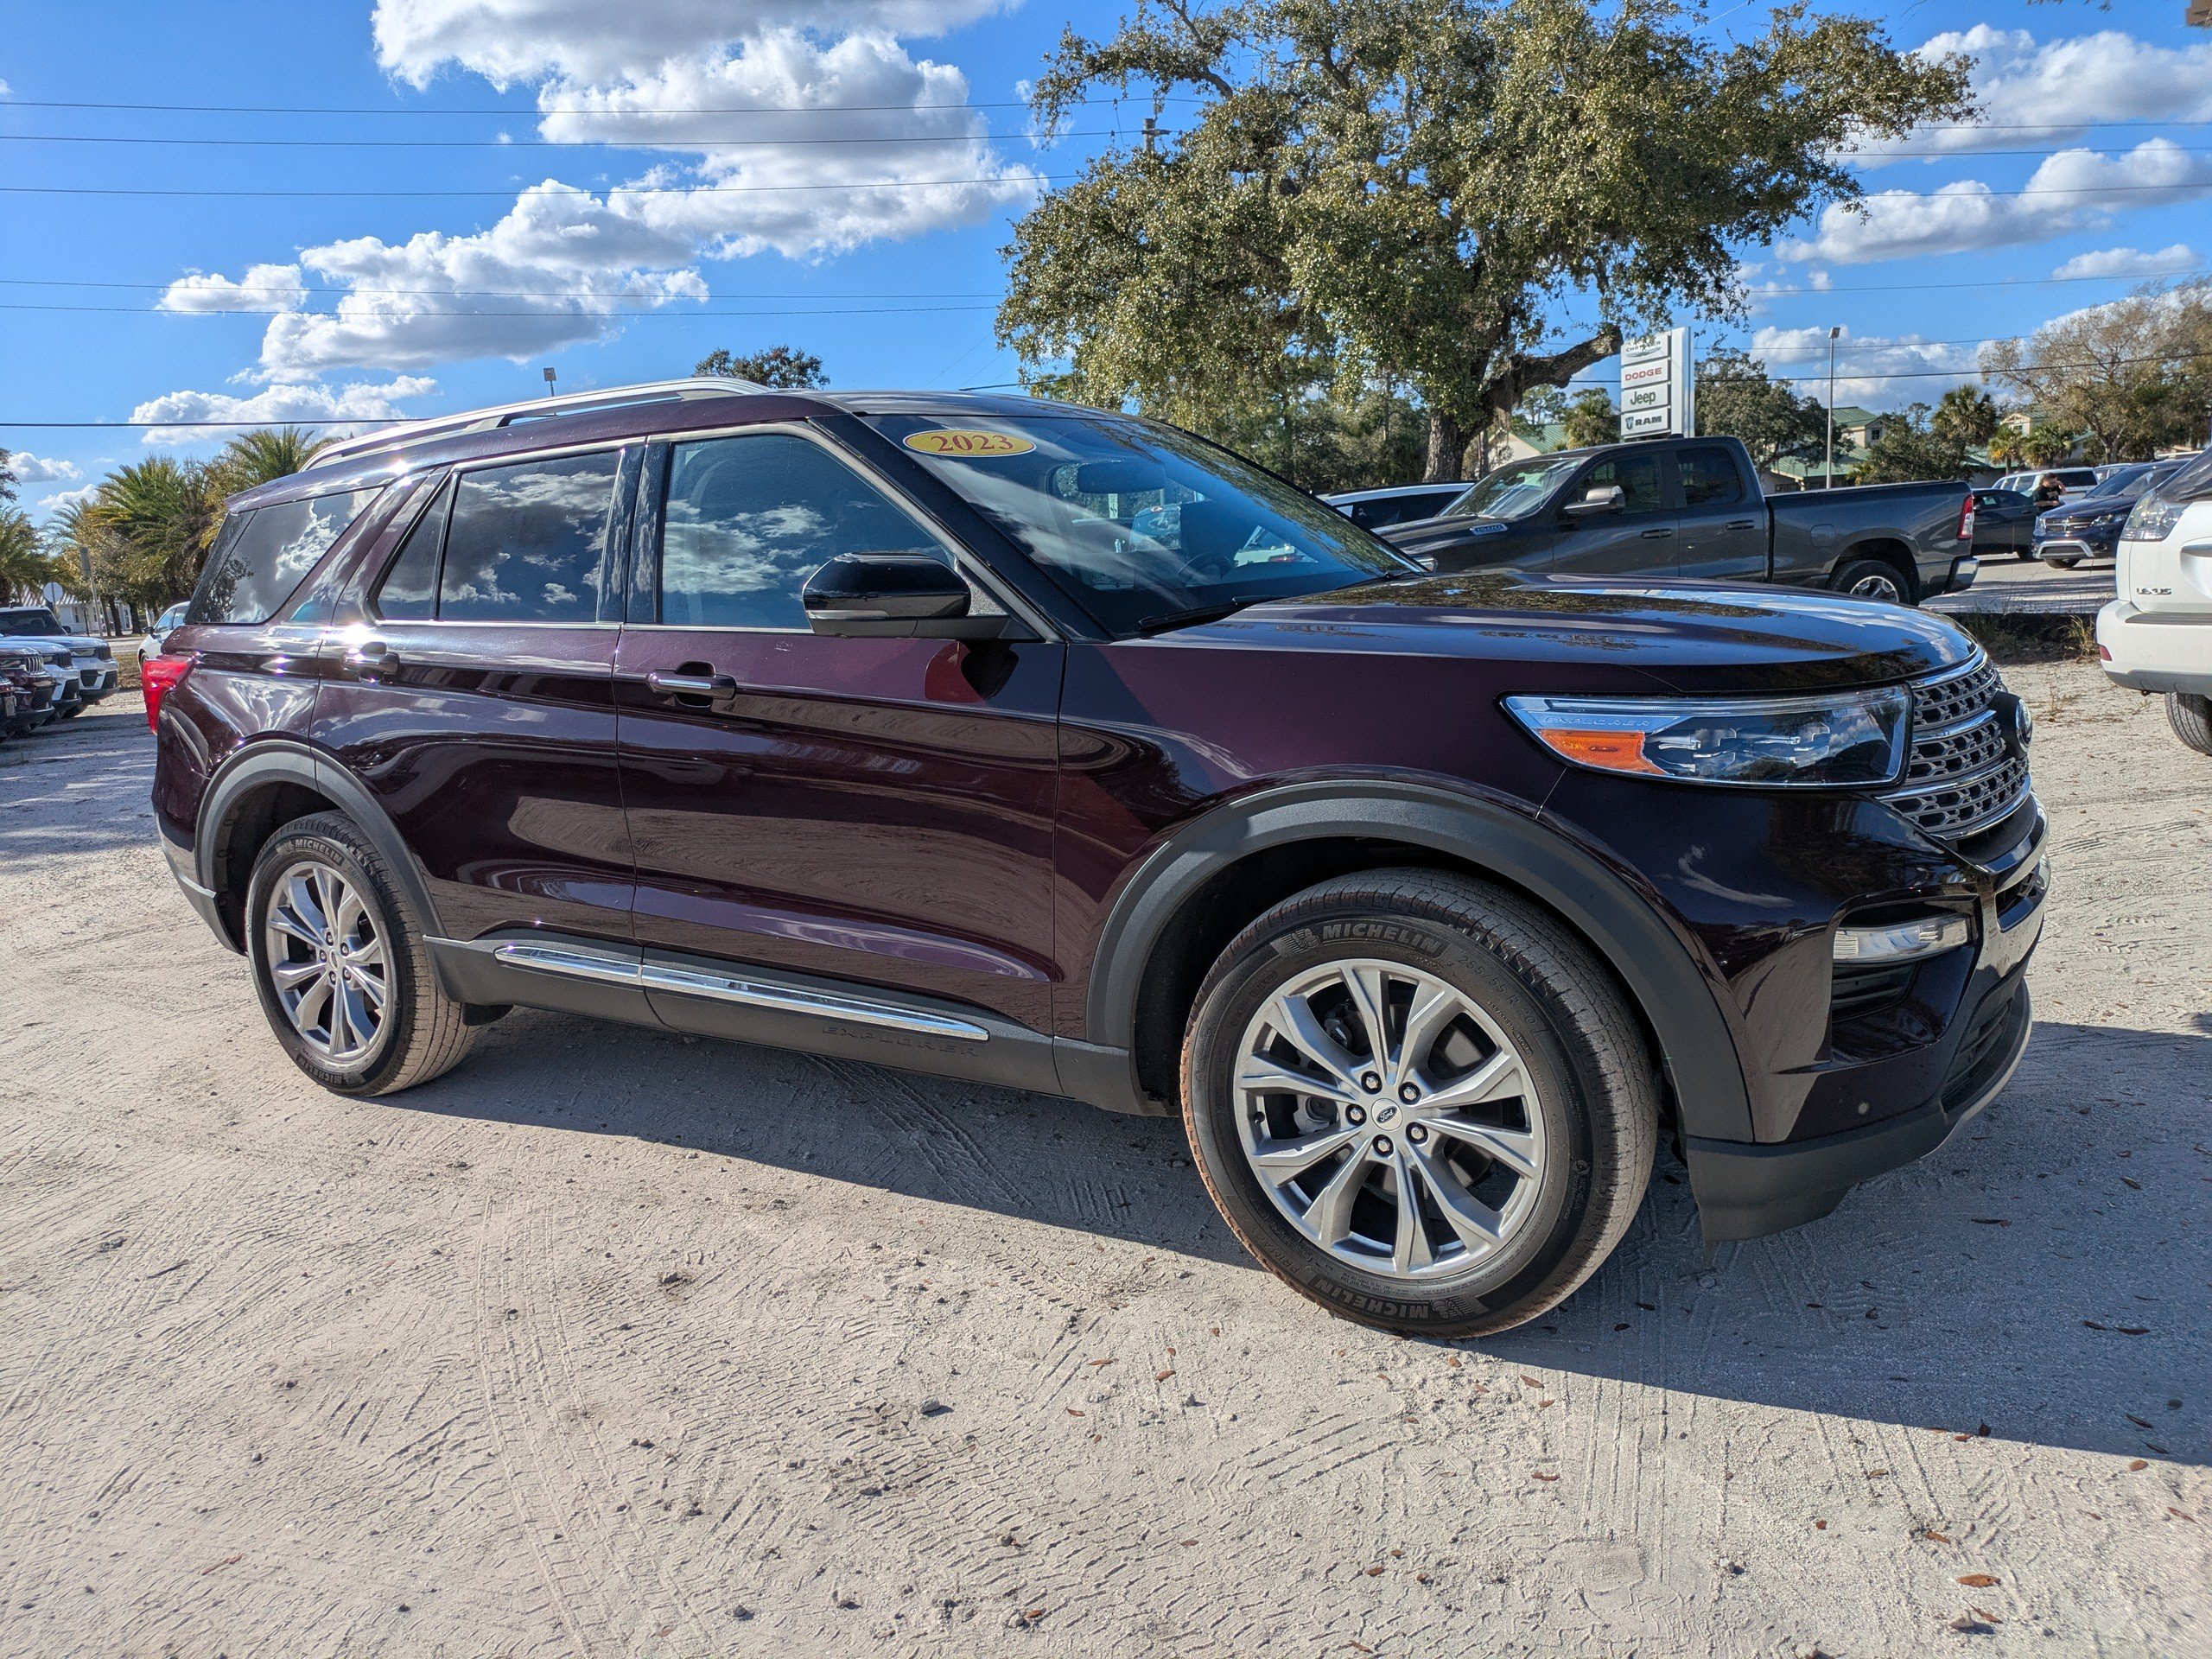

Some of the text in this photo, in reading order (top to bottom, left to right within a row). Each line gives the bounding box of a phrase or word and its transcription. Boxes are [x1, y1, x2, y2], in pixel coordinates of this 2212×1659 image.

[1624, 367, 1662, 381] DODGE
[1630, 391, 1656, 405] Jeep
[1635, 416, 1662, 426] RAM
[931, 435, 1014, 452] 2023
[1543, 716, 1649, 727] EXPLORER
[296, 839, 342, 863] MICHELIN
[1322, 924, 1441, 955] MICHELIN
[823, 1024, 977, 1057] EXPLORER
[298, 1055, 342, 1084] MICHELIN
[1249, 1225, 1301, 1274] PRIMACY
[1314, 1279, 1429, 1319] MICHELIN
